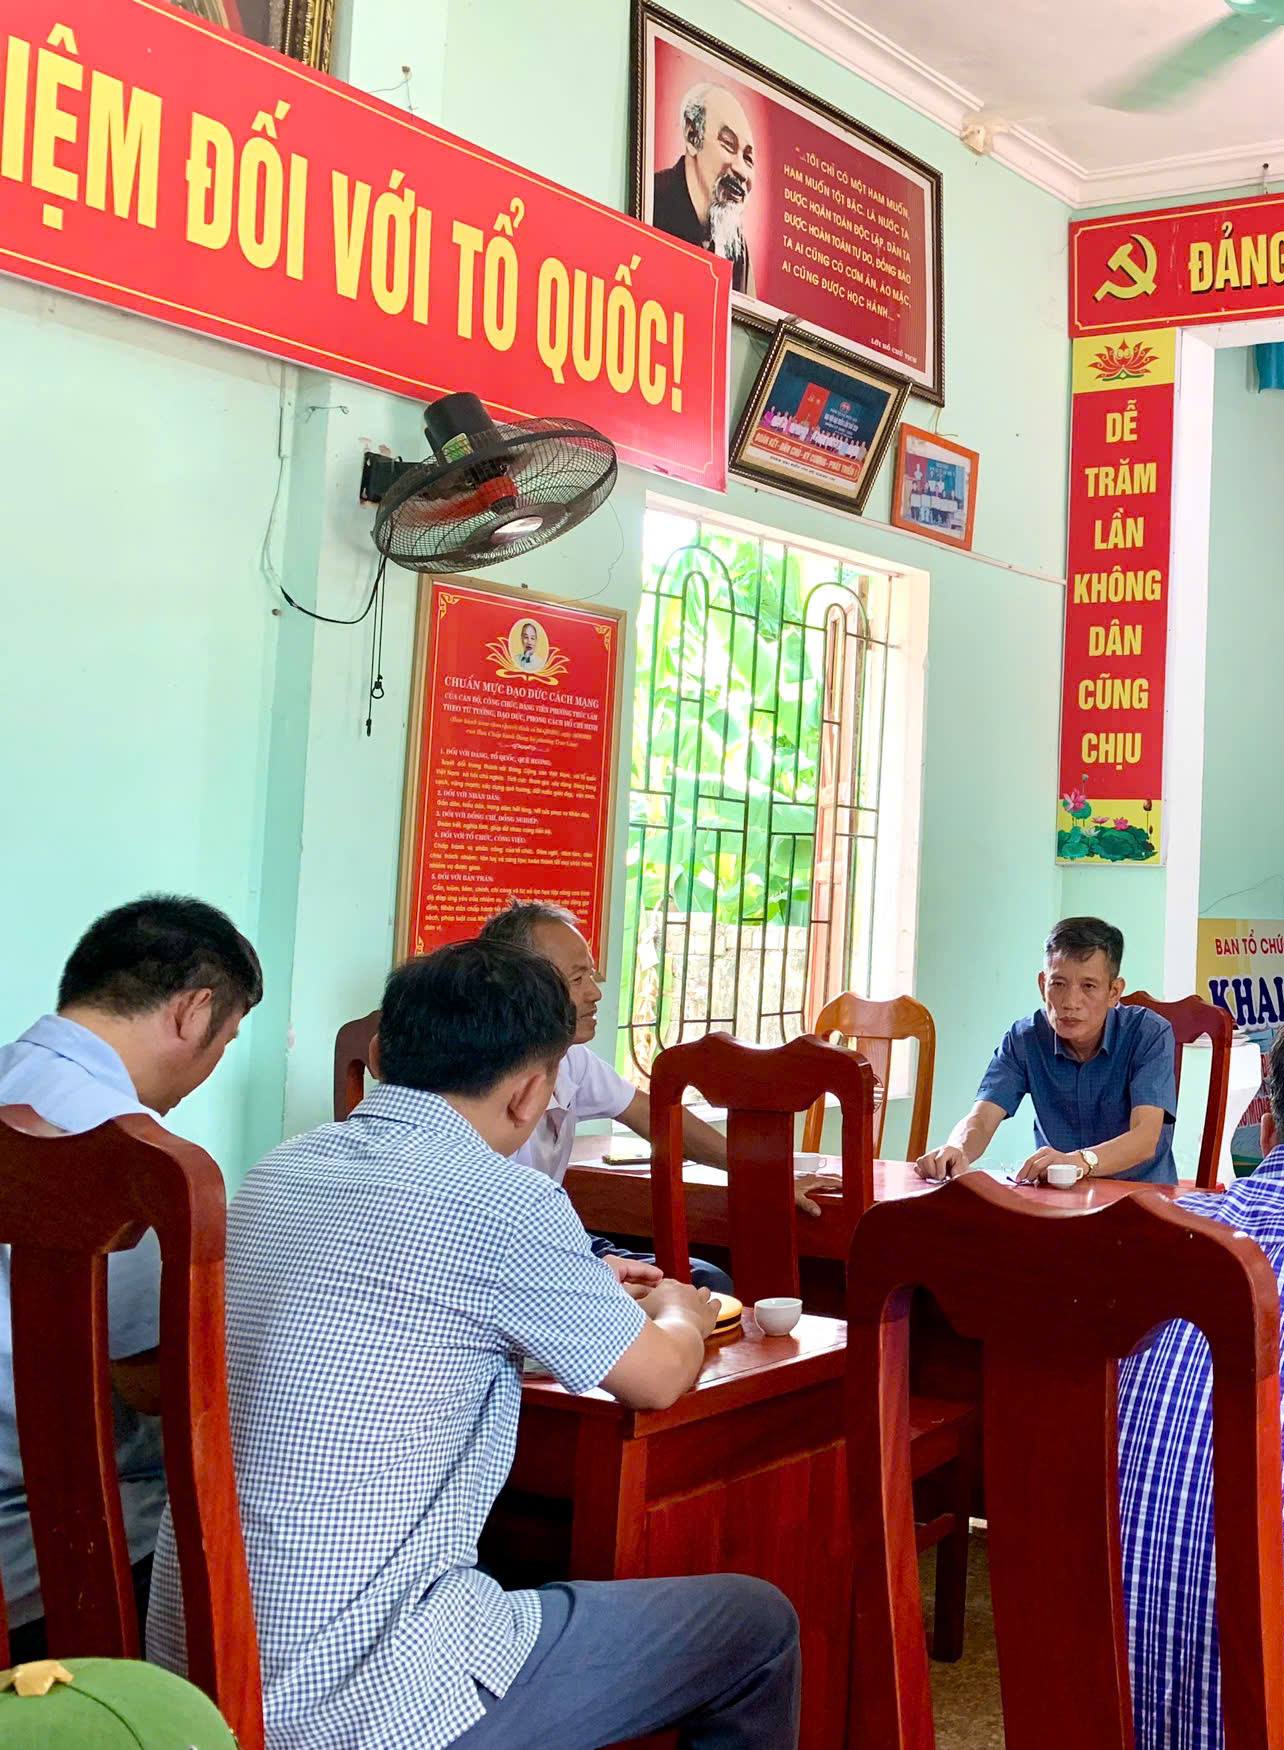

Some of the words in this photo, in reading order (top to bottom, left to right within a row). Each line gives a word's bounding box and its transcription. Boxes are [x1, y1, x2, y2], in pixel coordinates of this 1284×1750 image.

[784, 164, 803, 183] HAM
[805, 174, 830, 197] MUỐN
[877, 214, 900, 235] NƯỚC
[901, 227, 909, 240] TA
[186, 100, 307, 281] ĐỐI
[331, 169, 433, 324] VỚI
[452, 197, 525, 352] TỔ
[536, 254, 685, 413] QUỐC!
[1105, 399, 1138, 443] DỄ
[1084, 457, 1157, 497] TRĂM
[1094, 507, 1145, 550] LẦN
[1073, 565, 1162, 604] KHÔNG
[1088, 618, 1143, 657] DÂN
[1078, 673, 1149, 711] CŨNG
[1081, 732, 1142, 770] CHỊU
[1215, 938, 1240, 955] BAN
[1242, 929, 1257, 955] TỔ
